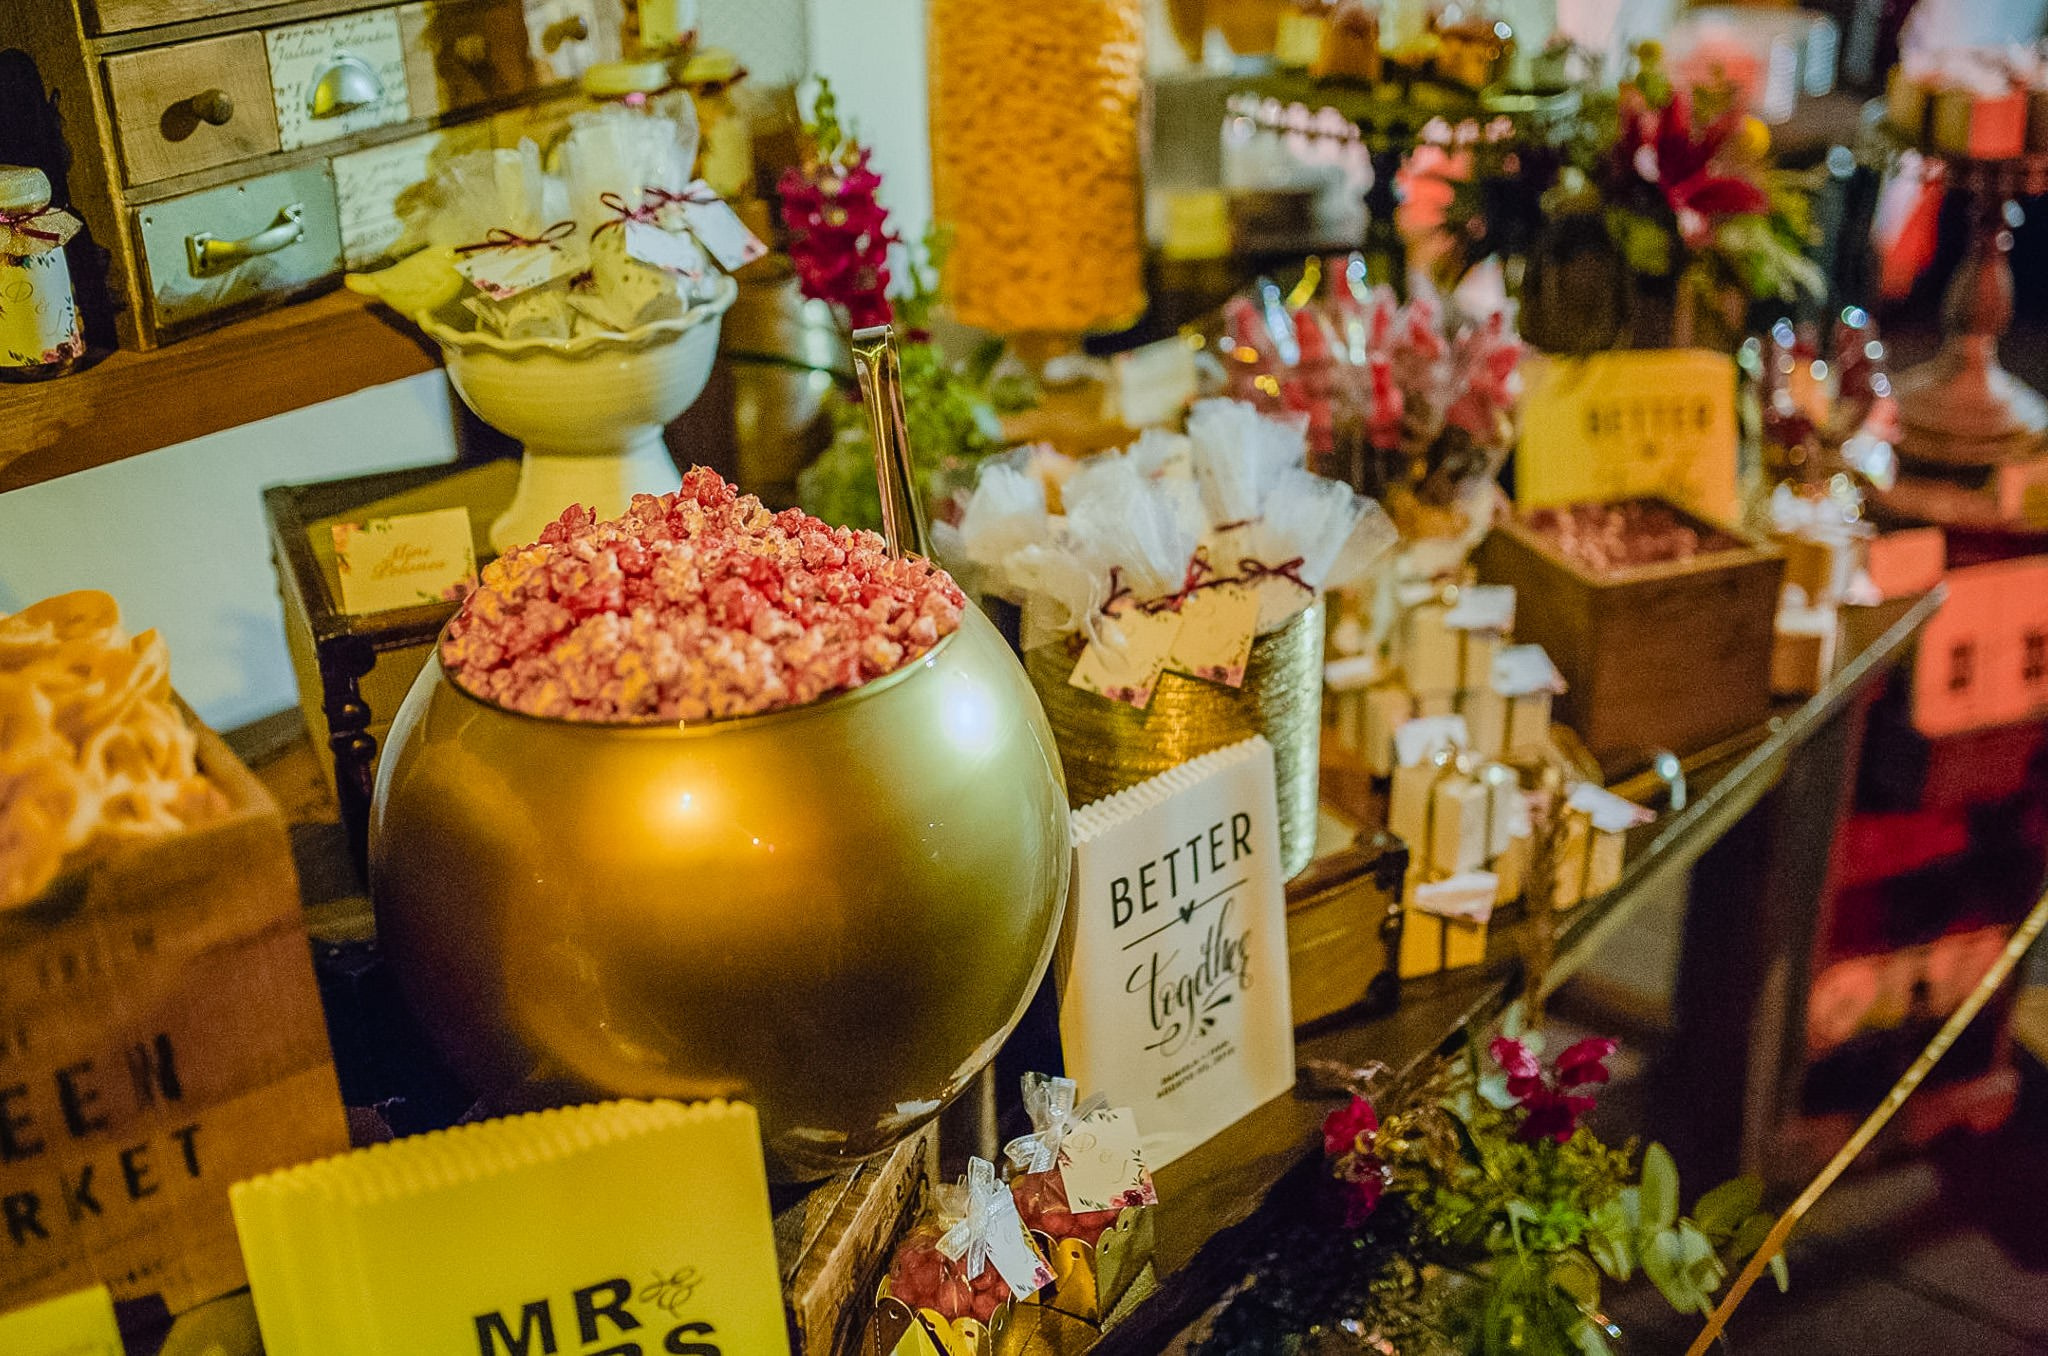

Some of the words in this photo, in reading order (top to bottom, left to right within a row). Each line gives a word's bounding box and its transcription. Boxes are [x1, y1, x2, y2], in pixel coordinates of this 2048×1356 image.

[1110, 812, 1252, 930] BETTER
[2, 1123, 201, 1246] RKET
[474, 1277, 643, 1356] MR
